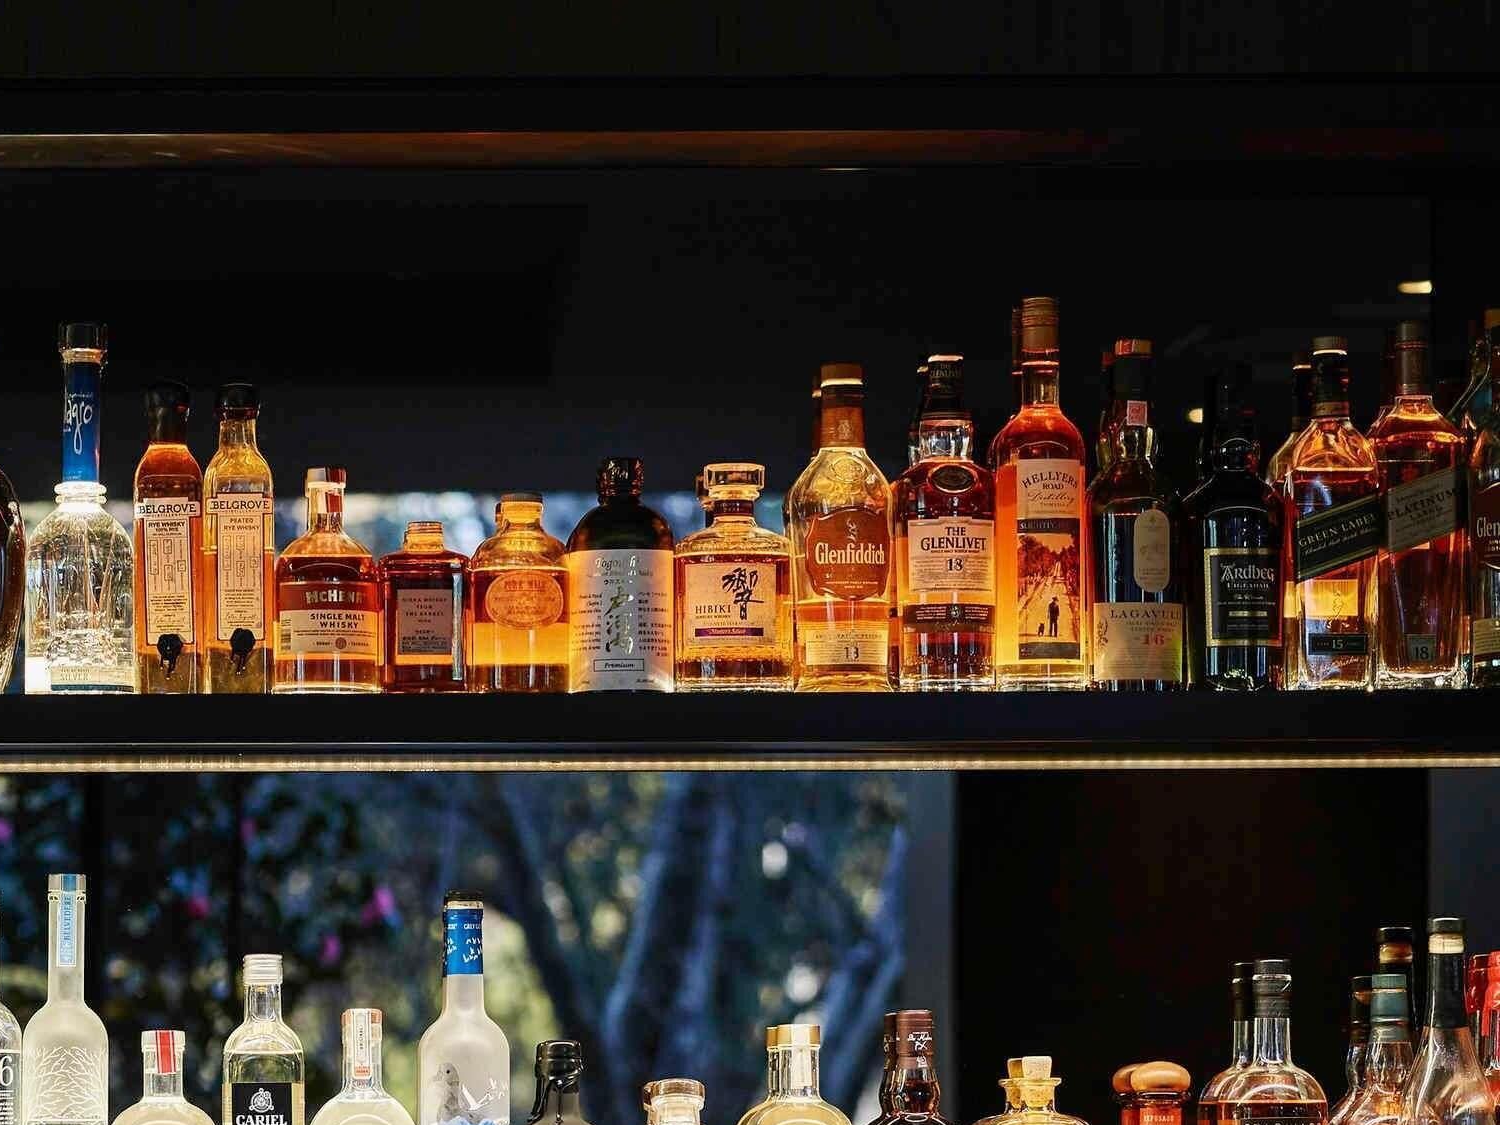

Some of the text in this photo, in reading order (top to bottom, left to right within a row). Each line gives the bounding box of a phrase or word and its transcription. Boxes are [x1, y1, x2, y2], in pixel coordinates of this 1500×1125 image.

[1021, 471, 1078, 489] HELLYERS
[139, 503, 197, 514] BELGROVE
[212, 500, 271, 510] BELGROVE
[1387, 487, 1459, 521] PLATINUM
[944, 526, 967, 537] THE
[1298, 512, 1378, 548] GREEN LABEL
[920, 536, 988, 552] GLENLIVET
[814, 541, 886, 566] Glenfiddich
[695, 605, 732, 615] HIBIKI
[310, 613, 365, 622] SINGLE MALT
[319, 621, 359, 629] WHISKY
